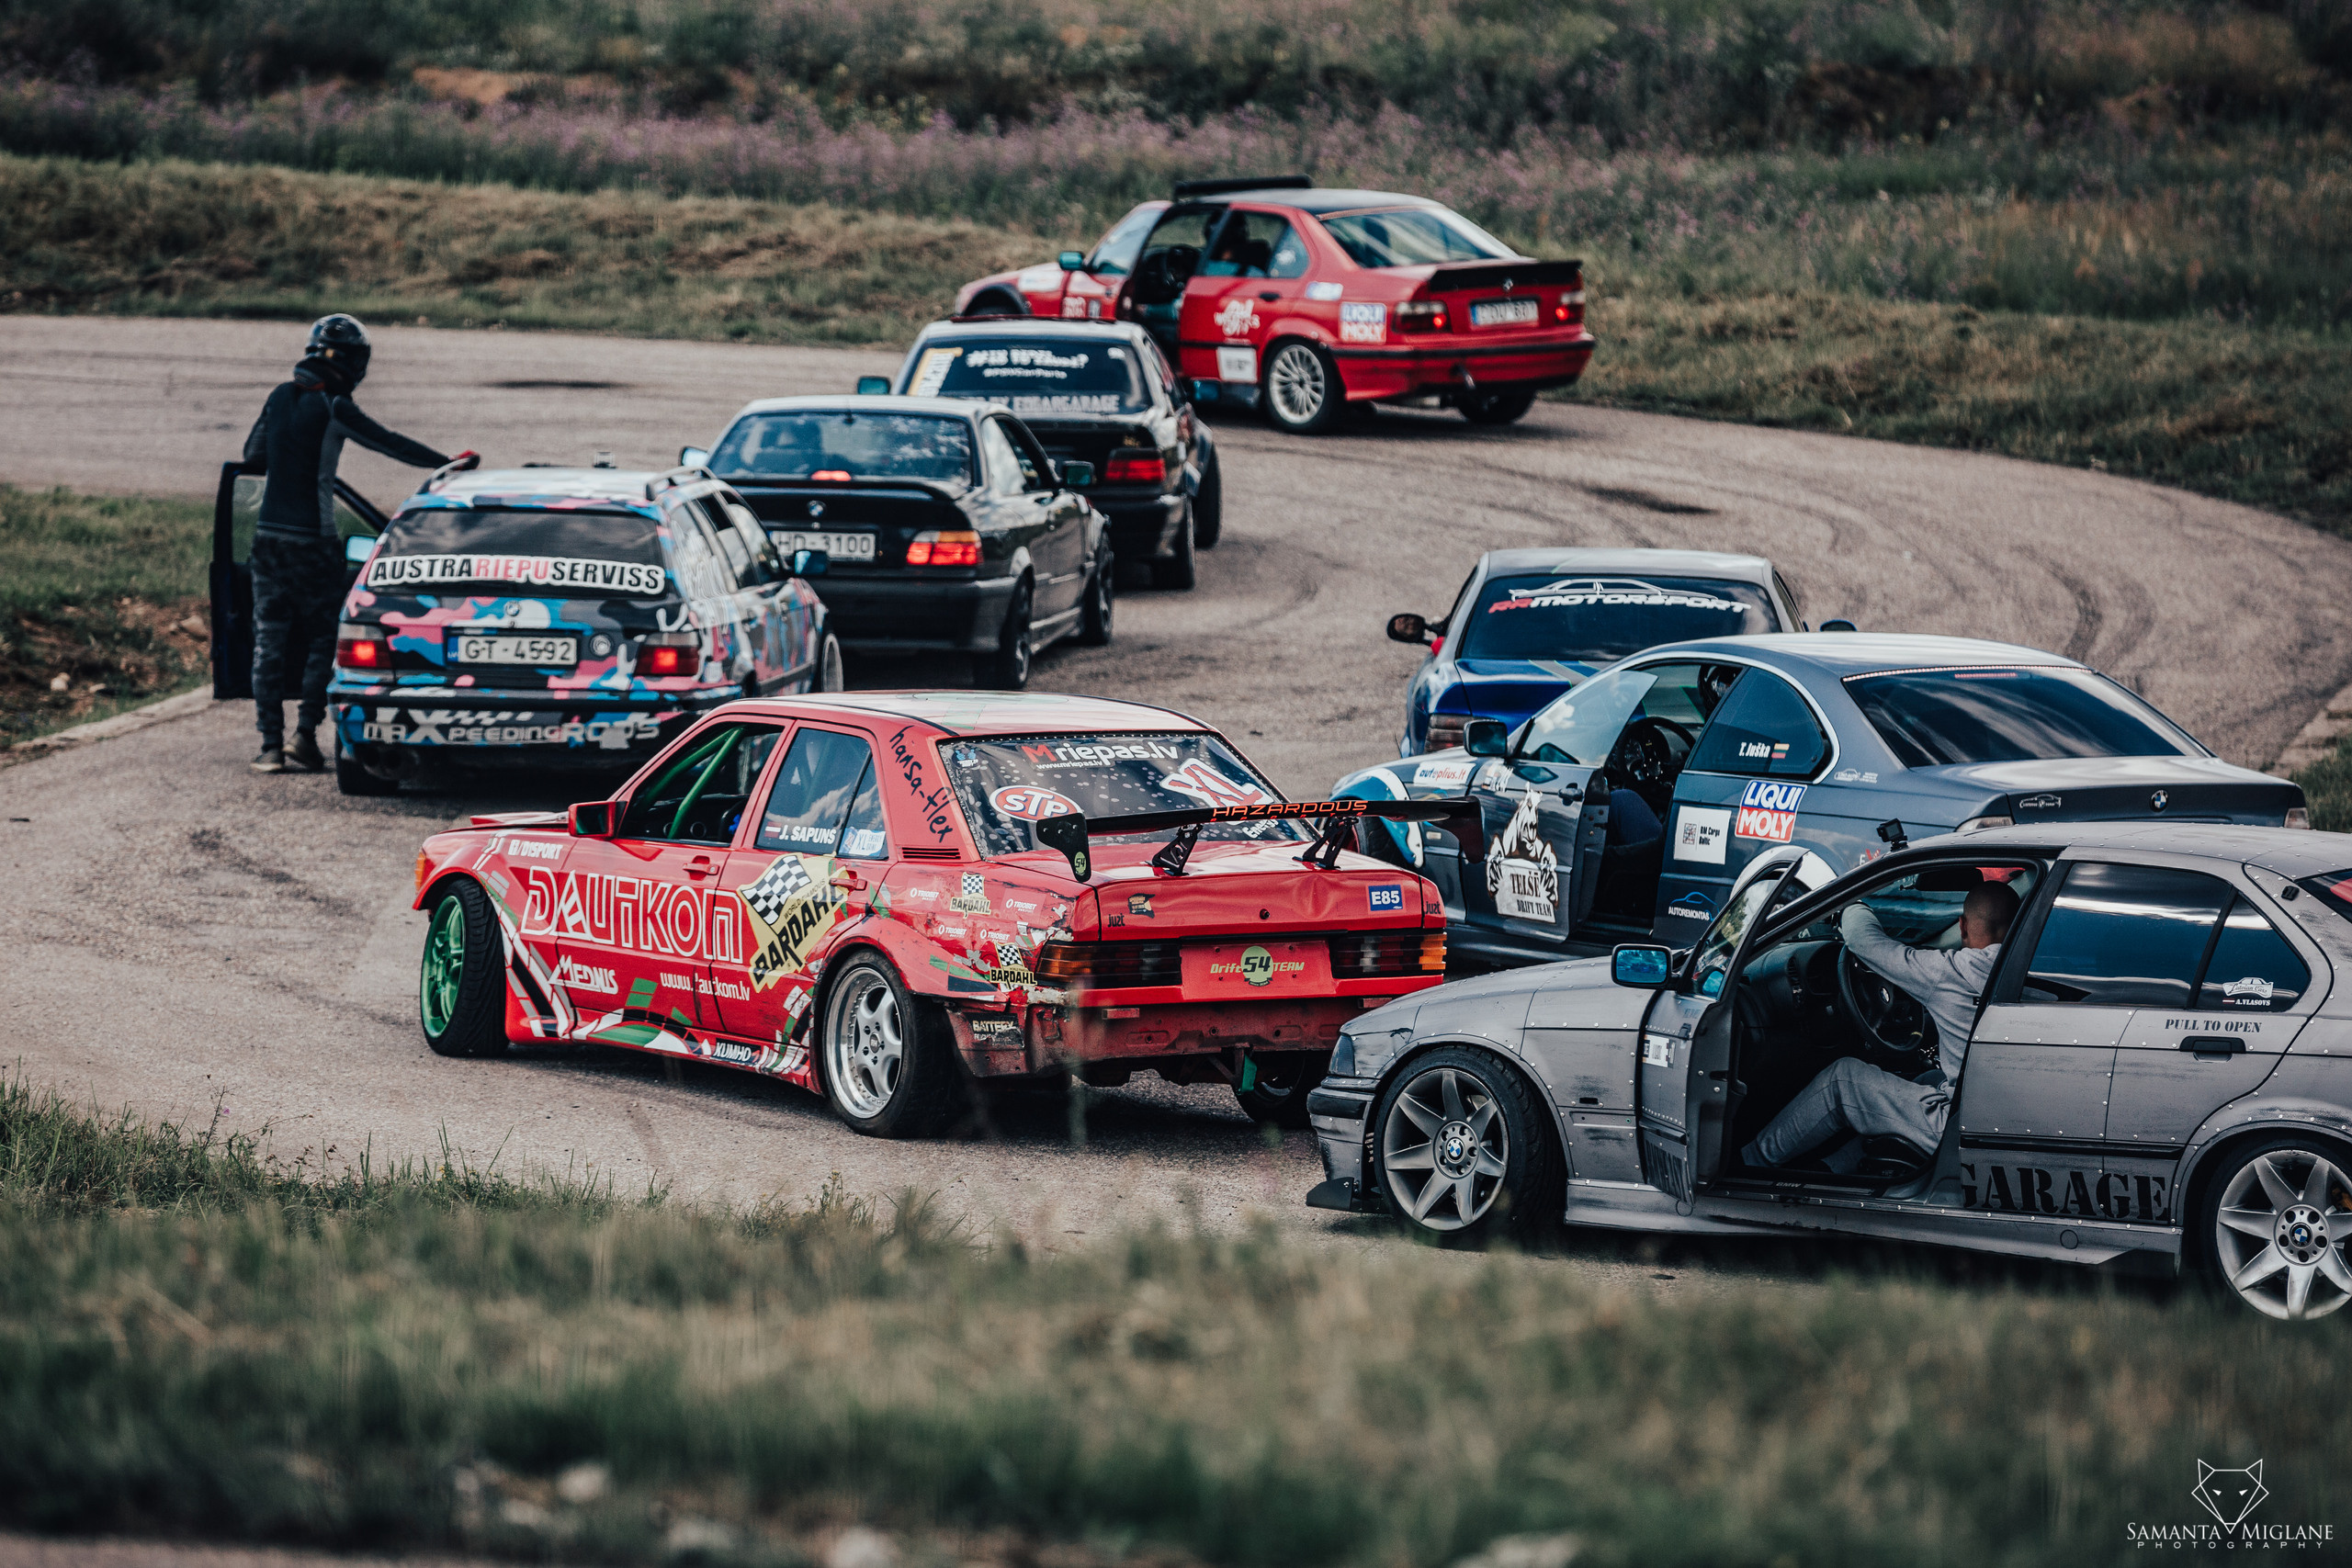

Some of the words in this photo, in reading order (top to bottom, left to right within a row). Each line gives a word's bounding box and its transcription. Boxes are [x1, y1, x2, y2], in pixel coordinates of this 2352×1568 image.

[1021, 741, 1179, 766] Mriepas.lv
[1002, 790, 1070, 818] STP
[1744, 782, 1802, 810] LIQUI
[1213, 801, 1368, 818] HAZARDOUS
[1738, 810, 1794, 838] MOLY
[779, 826, 791, 840] J.
[791, 825, 837, 844] SAPUNS
[951, 897, 990, 914] BARDAHL
[1371, 891, 1400, 905] E85
[1535, 902, 1553, 917] TEAM
[1668, 906, 1710, 921] AUTOREMONTAS
[753, 882, 844, 986] BARDAHL
[1210, 963, 1242, 974] Drift
[1243, 956, 1272, 973] 54
[1273, 962, 1305, 972] TEAM
[548, 955, 618, 994] MEDNIS
[990, 969, 1036, 986] BARDAHL
[2165, 1019, 2199, 1032] PULL
[2204, 1021, 2222, 1032] TO
[2224, 1021, 2262, 1034] OPEN
[714, 1042, 752, 1062] KUMHO
